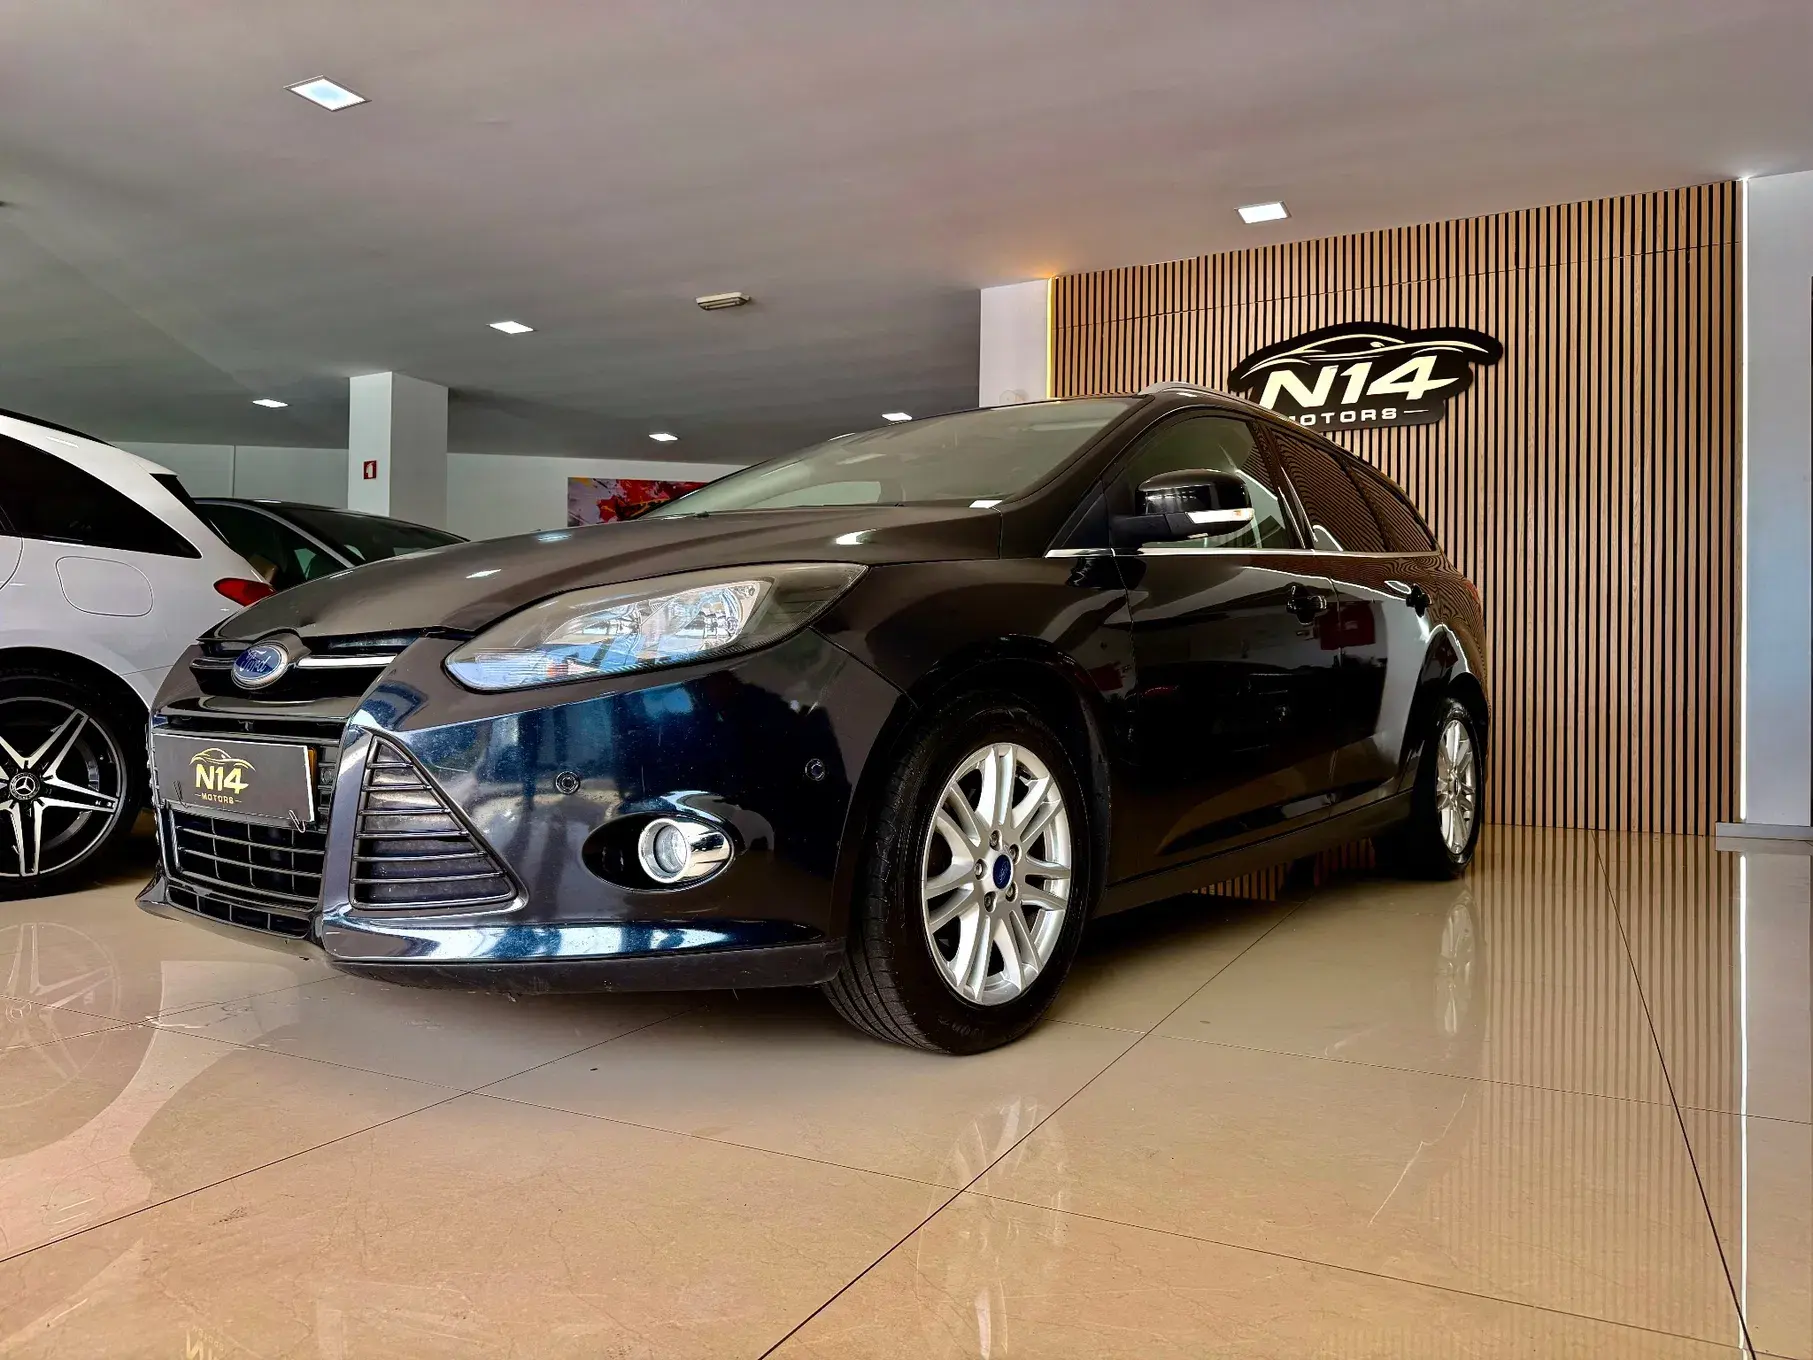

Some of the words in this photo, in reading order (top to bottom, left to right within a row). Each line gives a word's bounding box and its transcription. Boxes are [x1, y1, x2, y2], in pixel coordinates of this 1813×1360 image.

[1259, 355, 1459, 410] N14
[239, 649, 272, 673] Ford
[195, 763, 249, 794] N14
[201, 792, 234, 804] MOTORS
